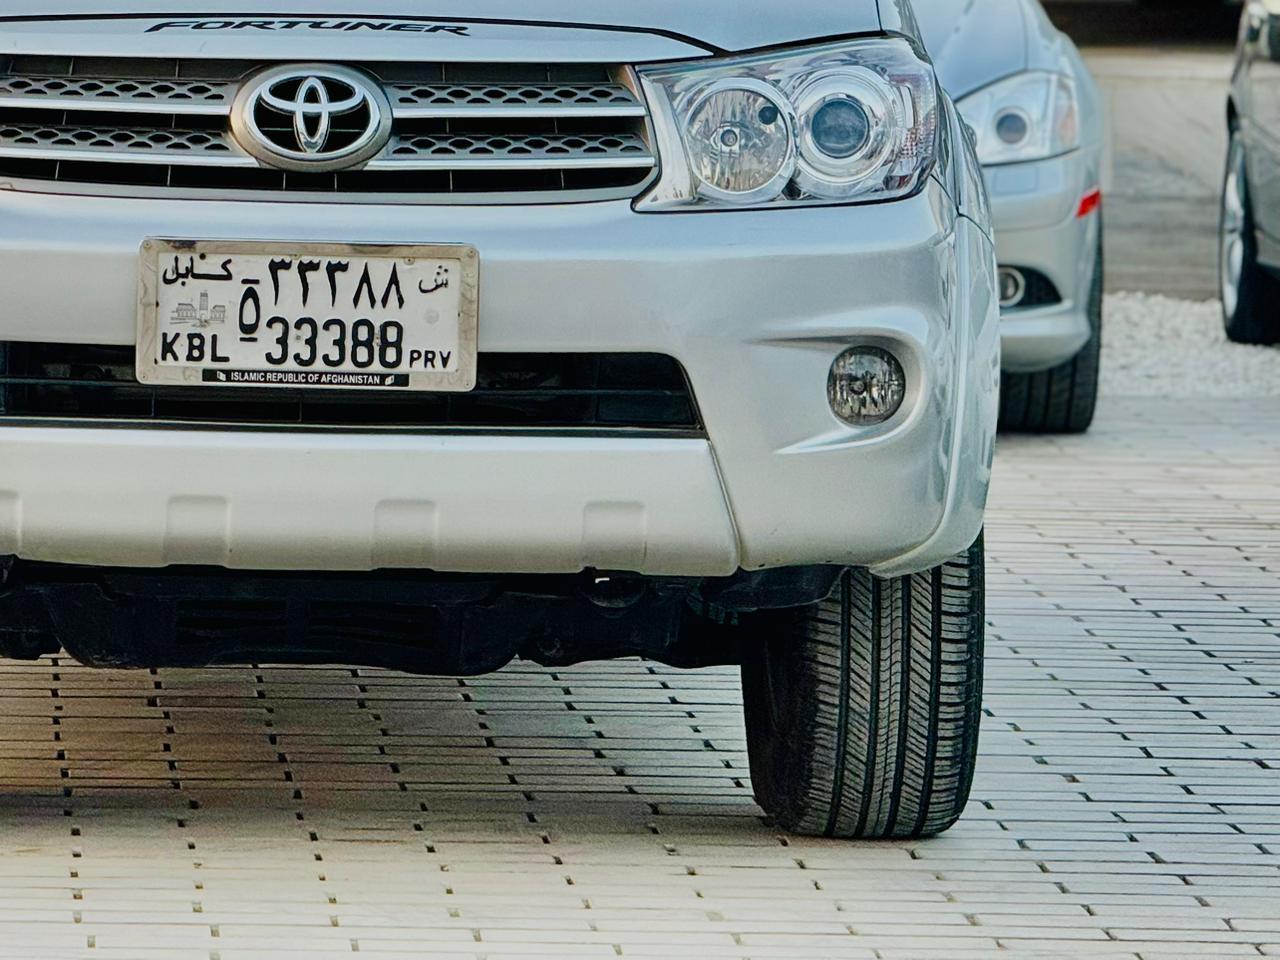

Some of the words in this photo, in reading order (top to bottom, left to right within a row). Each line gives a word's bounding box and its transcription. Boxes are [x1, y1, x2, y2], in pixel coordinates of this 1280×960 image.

[144, 20, 471, 37] FORTUNER
[162, 255, 234, 287] کابل
[160, 332, 231, 364] KBL
[265, 316, 404, 369] 33388
[409, 349, 452, 369] PRV
[231, 371, 265, 382] ISLAMIC
[266, 372, 306, 383] REPUBLIC
[307, 373, 320, 383] OF
[320, 374, 381, 385] AFGHANISTAN
